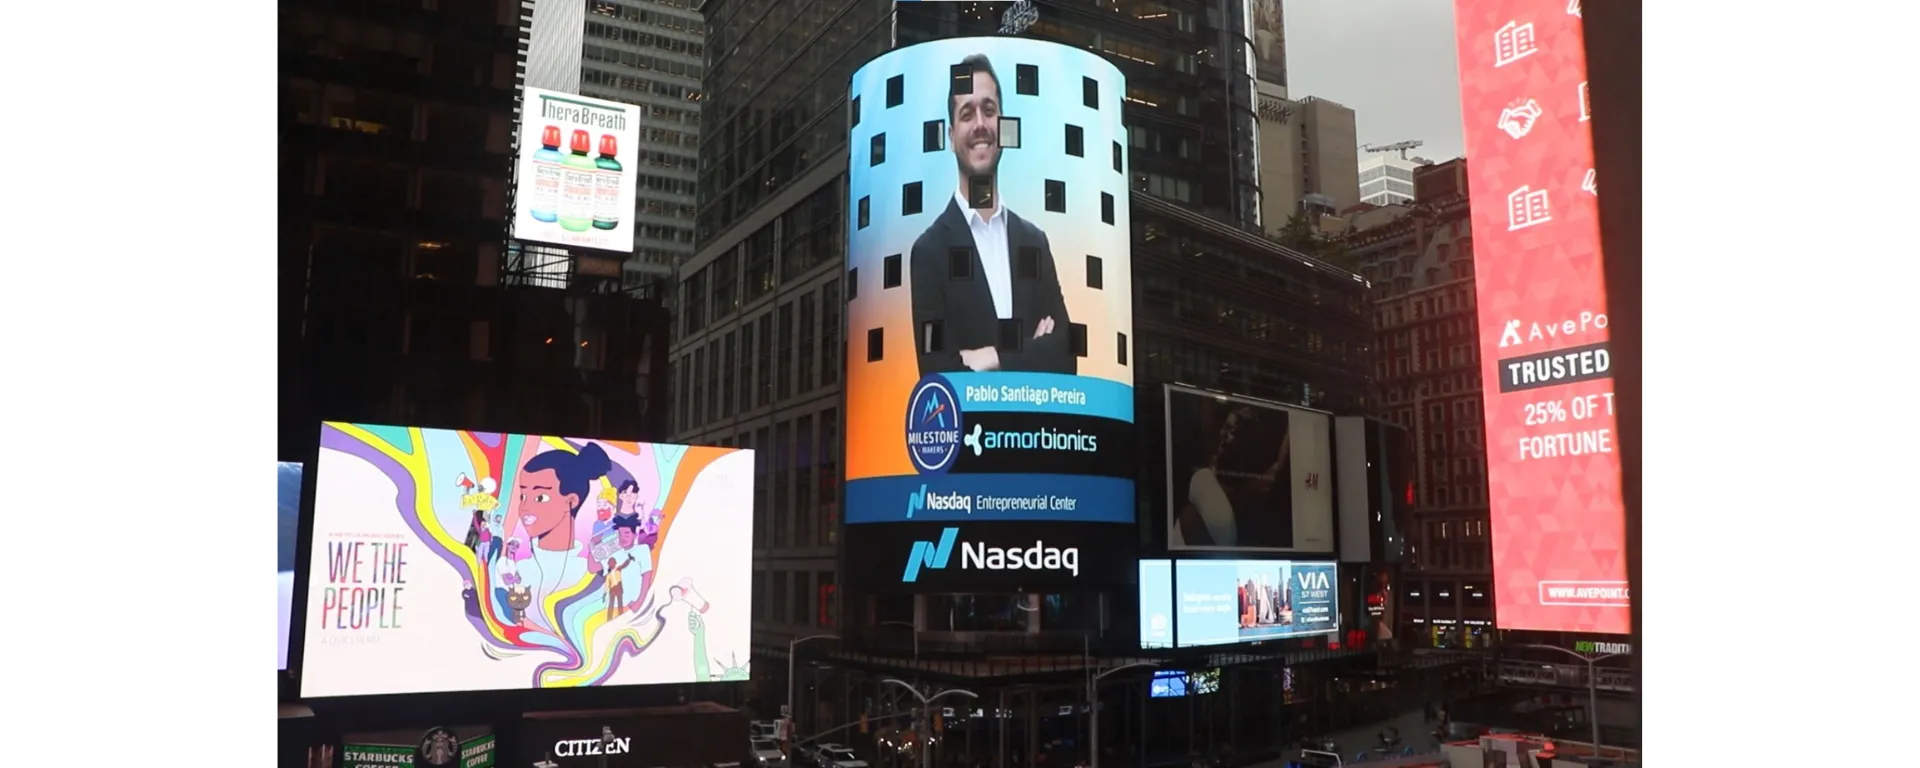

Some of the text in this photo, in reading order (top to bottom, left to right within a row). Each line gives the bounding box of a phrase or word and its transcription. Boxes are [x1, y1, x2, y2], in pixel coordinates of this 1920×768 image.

[539, 94, 626, 132] TheraBreath
[1528, 311, 1608, 342] AvePo
[1508, 349, 1610, 385] TRUSTED
[966, 385, 1086, 405] Pablo Santiago Pereira
[1524, 400, 1567, 426] 25%
[1571, 395, 1599, 420] OF
[908, 430, 959, 445] MILESTONE
[984, 427, 1097, 452] armorbionics
[1519, 429, 1612, 460] FORTUNE
[921, 446, 944, 454] MAKERS
[926, 491, 1077, 514] Nasdaq Entrepreneurial Center
[328, 541, 408, 584] WE THE
[961, 540, 1079, 577] Nasdaq
[1297, 571, 1330, 590] VIA
[1311, 590, 1328, 598] WEST
[321, 587, 404, 630] PEOPLE
[344, 752, 413, 764] STARBUCKS
[461, 740, 496, 759] STARBUCKS
[554, 737, 631, 757] CITIZEN
[466, 753, 488, 768] COFFEE
